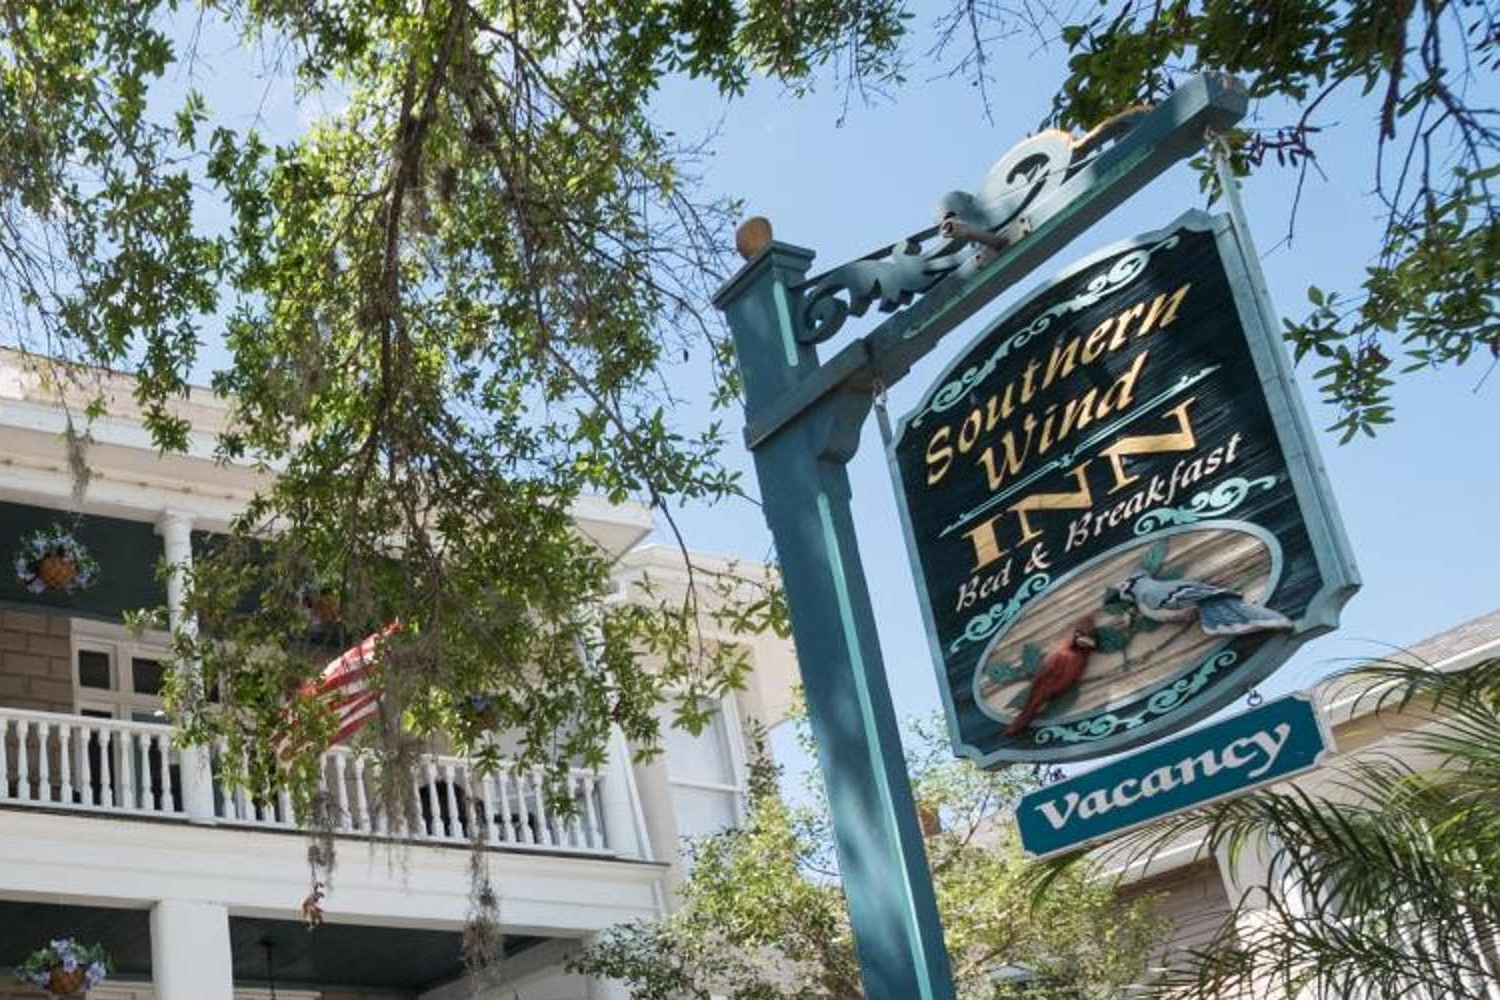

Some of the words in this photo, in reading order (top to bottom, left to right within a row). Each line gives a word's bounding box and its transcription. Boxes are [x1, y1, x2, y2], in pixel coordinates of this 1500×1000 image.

[925, 283, 1191, 486] Southern
[976, 351, 1149, 491] Wind
[956, 559, 1012, 612] Bed
[1024, 541, 1051, 572] &
[1064, 432, 1243, 552] Breakfast
[962, 397, 1197, 574] INN
[1035, 722, 1291, 830] Vacancy
